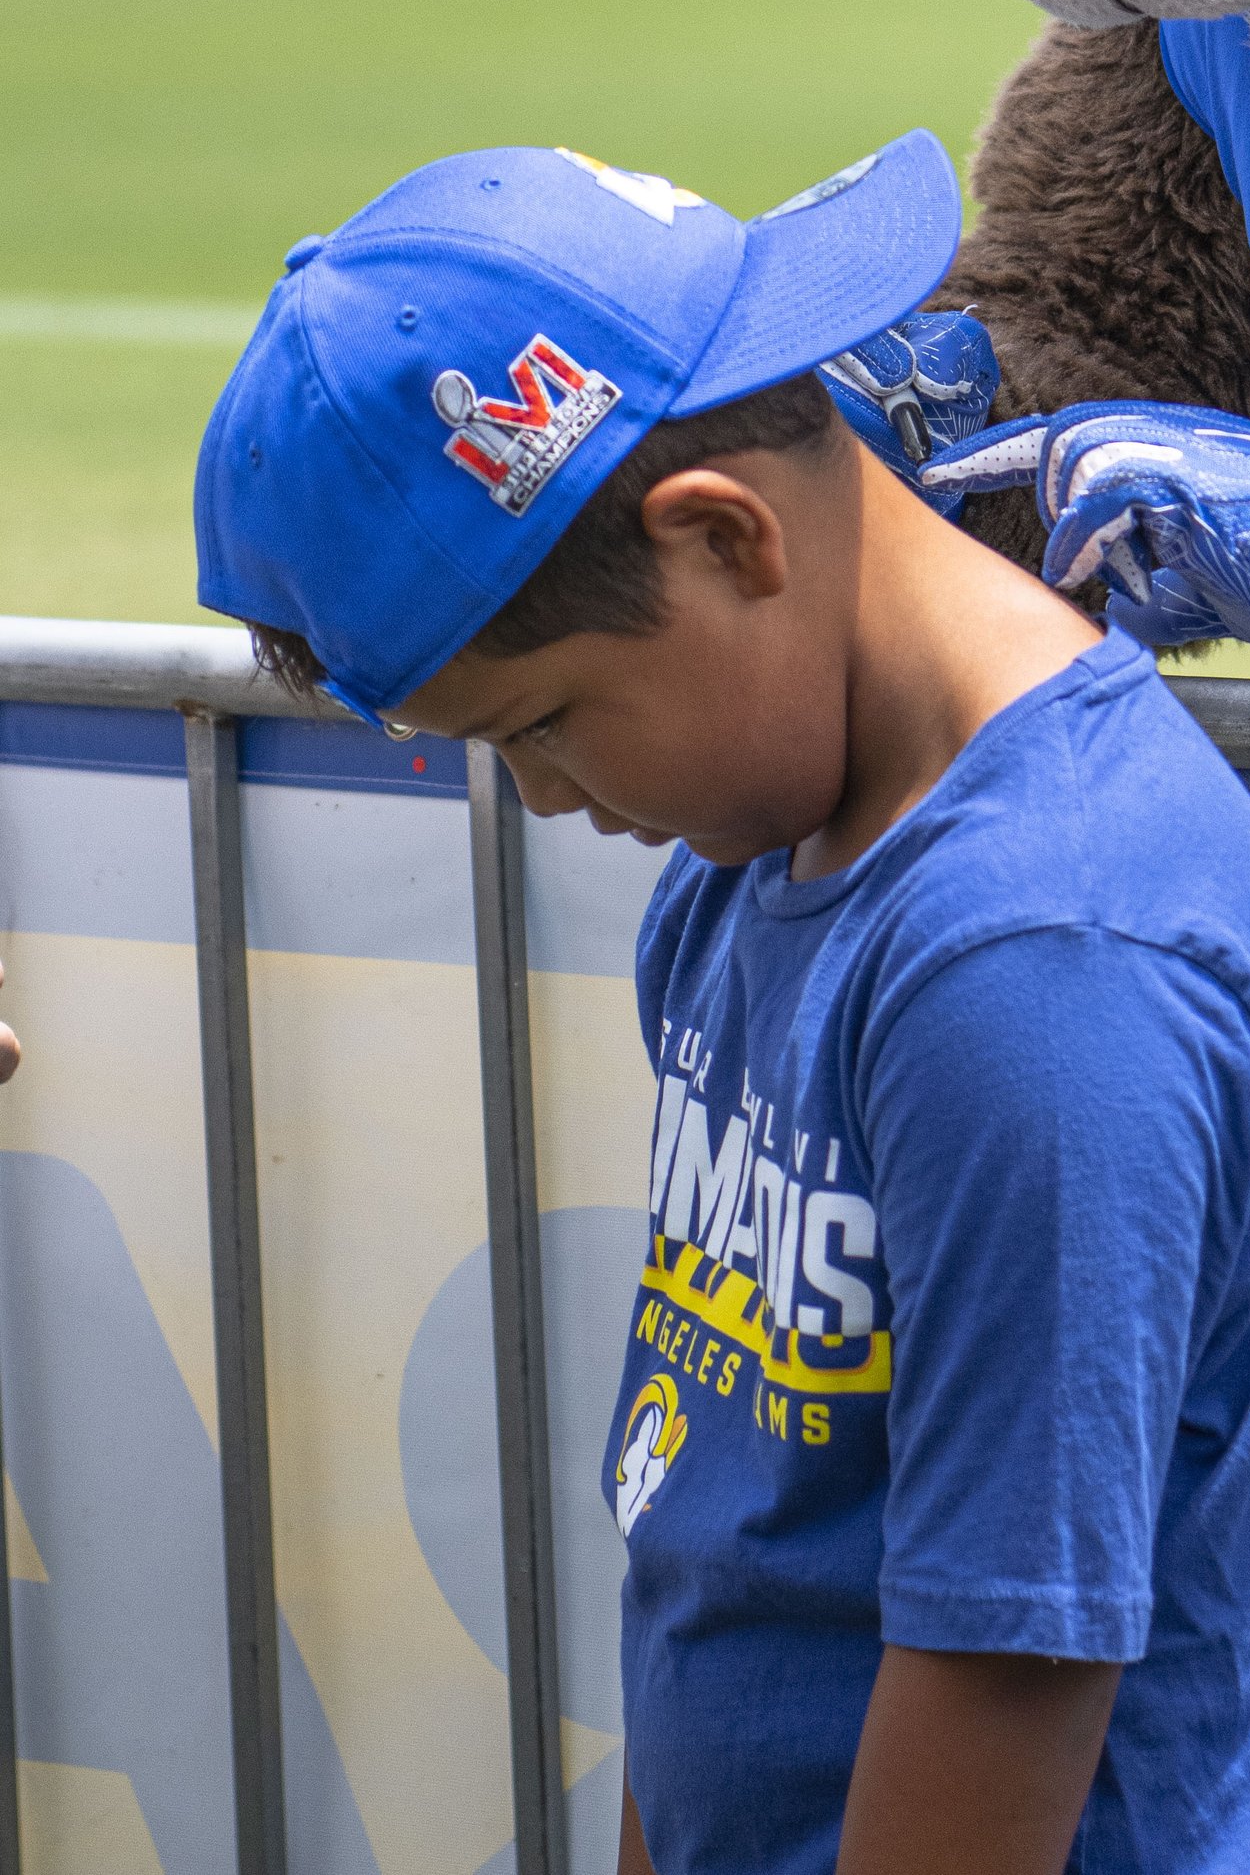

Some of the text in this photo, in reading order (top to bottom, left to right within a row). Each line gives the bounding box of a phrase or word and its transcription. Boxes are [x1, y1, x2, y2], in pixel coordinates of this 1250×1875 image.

[447, 337, 588, 487] LVI
[511, 391, 612, 505] CHAMPIONS
[636, 1299, 743, 1397] NGELES
